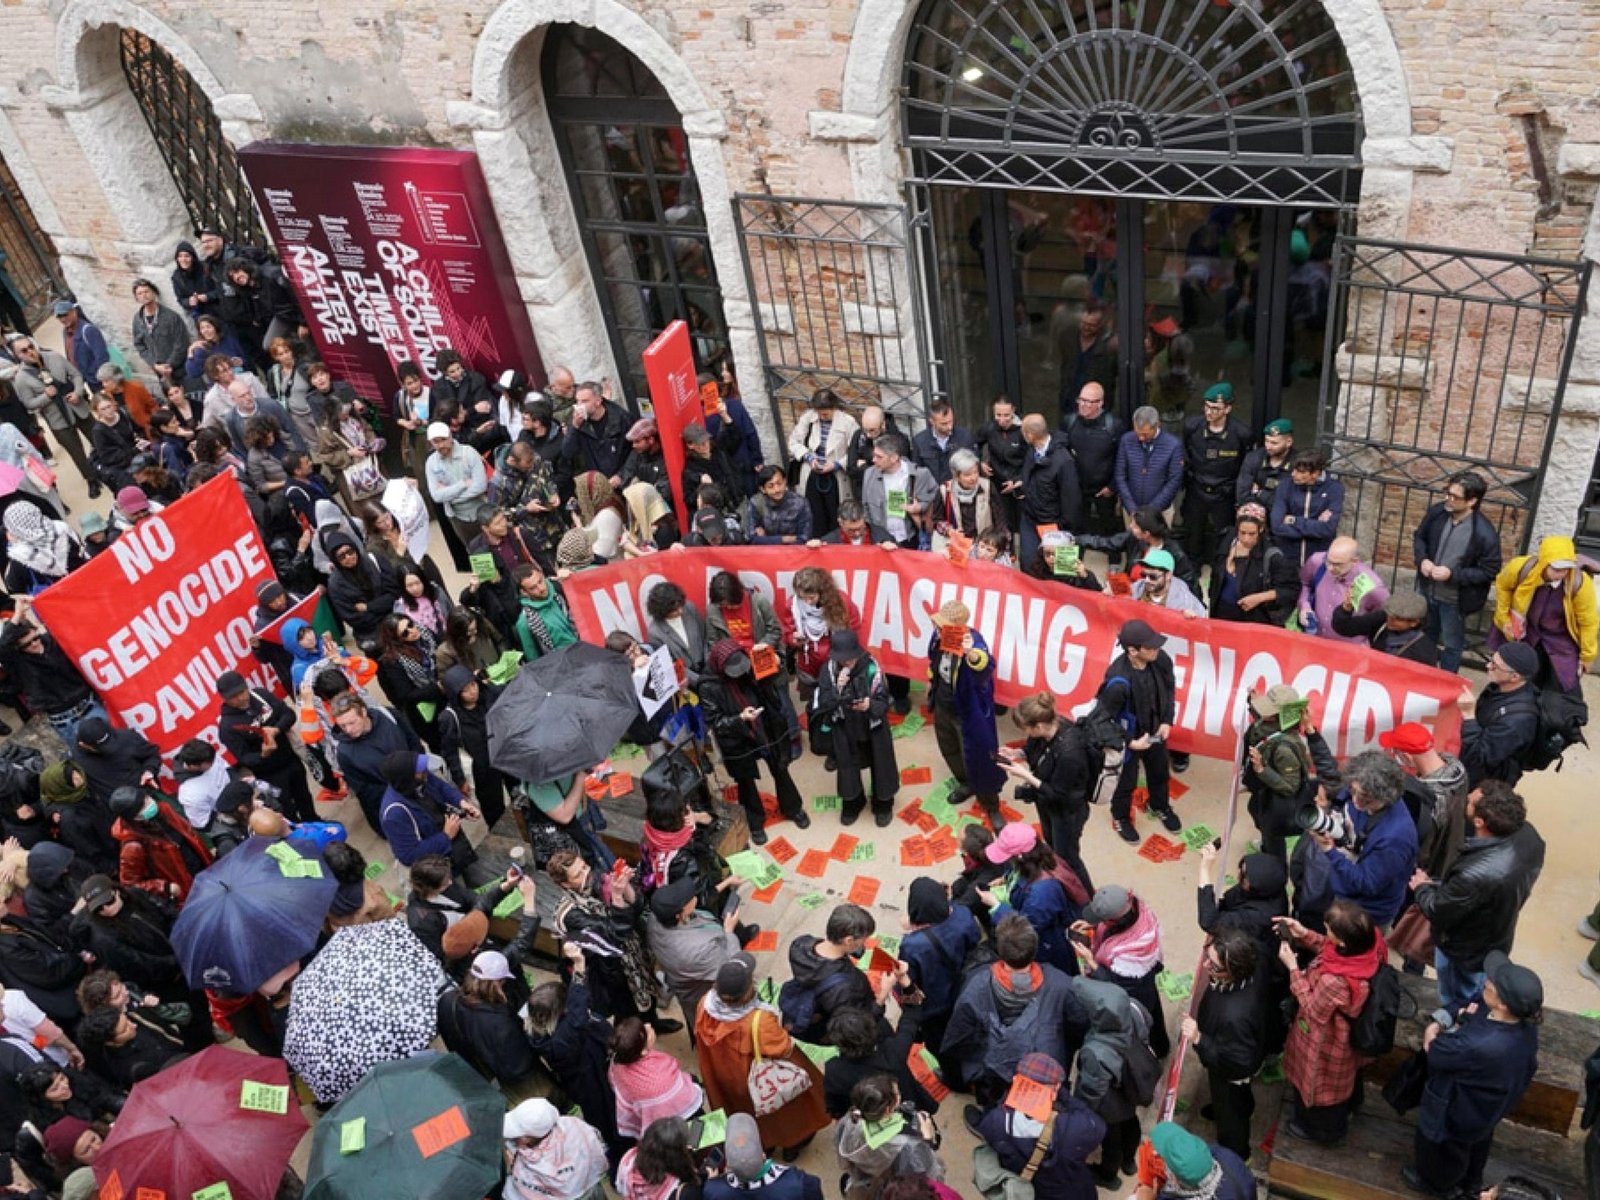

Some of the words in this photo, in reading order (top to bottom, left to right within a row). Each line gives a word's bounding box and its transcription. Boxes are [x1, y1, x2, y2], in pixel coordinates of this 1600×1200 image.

[287, 245, 345, 345] NATIVE
[306, 245, 358, 336] ALTER
[341, 270, 388, 351] EXIST
[376, 240, 407, 281] OF
[393, 283, 442, 380] SOUND
[395, 241, 419, 265] A
[408, 269, 451, 350] CHILD
[110, 516, 175, 584] NO
[79, 532, 266, 691] GENOCIDE
[1108, 632, 1440, 757] ENOID
